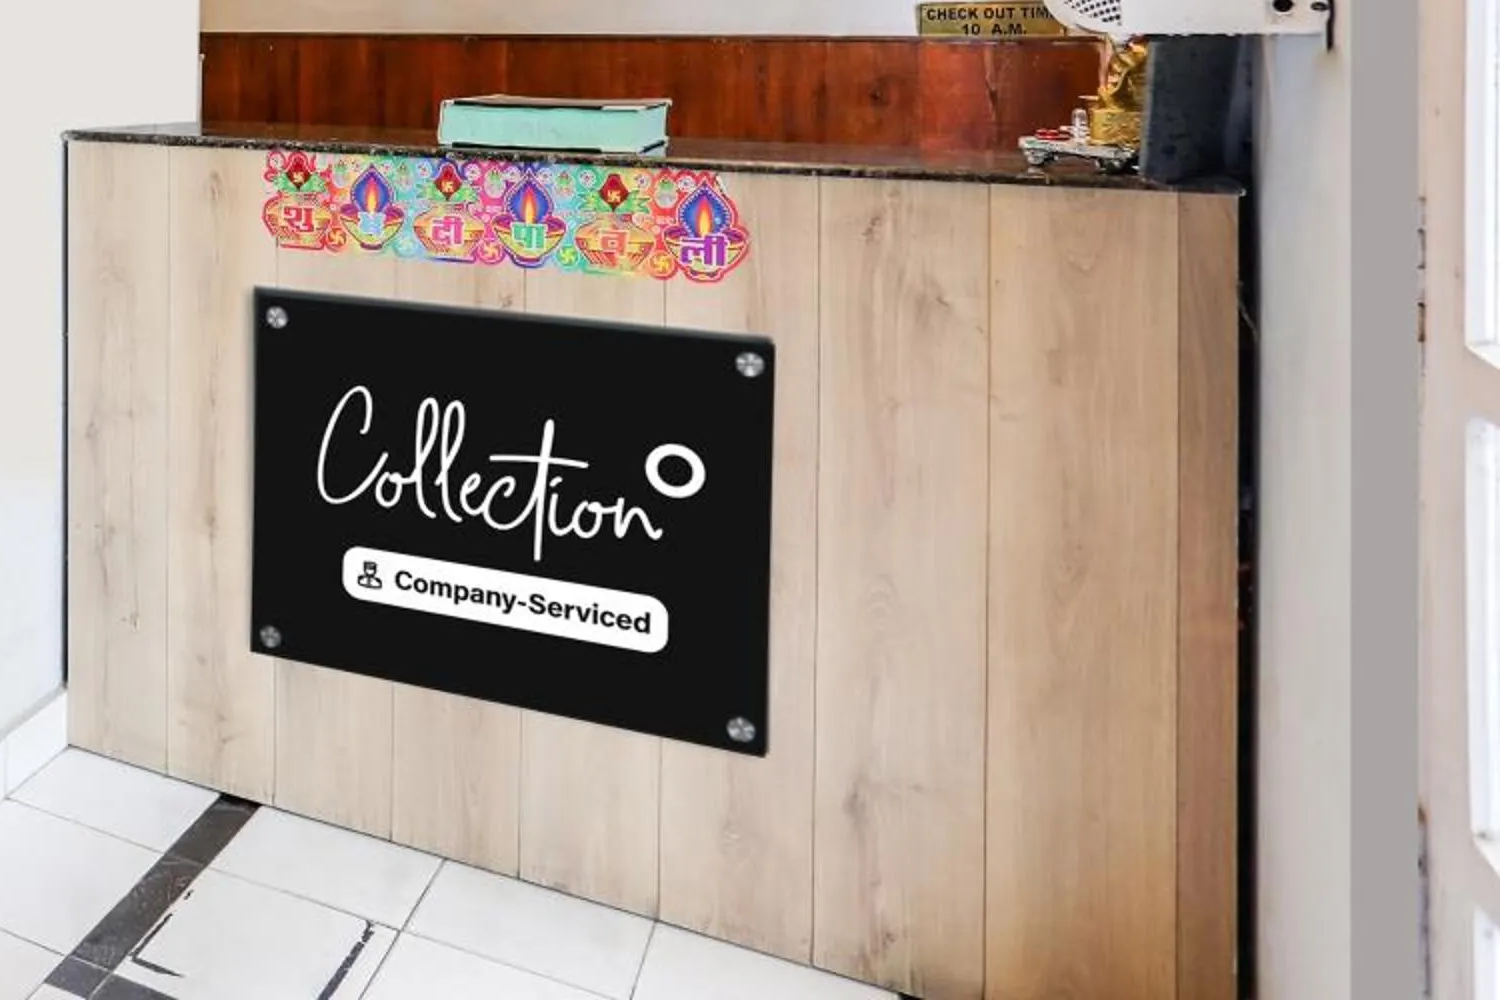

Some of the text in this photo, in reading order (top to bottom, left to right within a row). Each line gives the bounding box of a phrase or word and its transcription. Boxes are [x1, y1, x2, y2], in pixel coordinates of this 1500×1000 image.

[926, 5, 1055, 21] CHECK OUT TIM
[961, 23, 1028, 36] 10 A.M.
[317, 384, 664, 563] Collection
[394, 569, 652, 635] Company-Serviced
